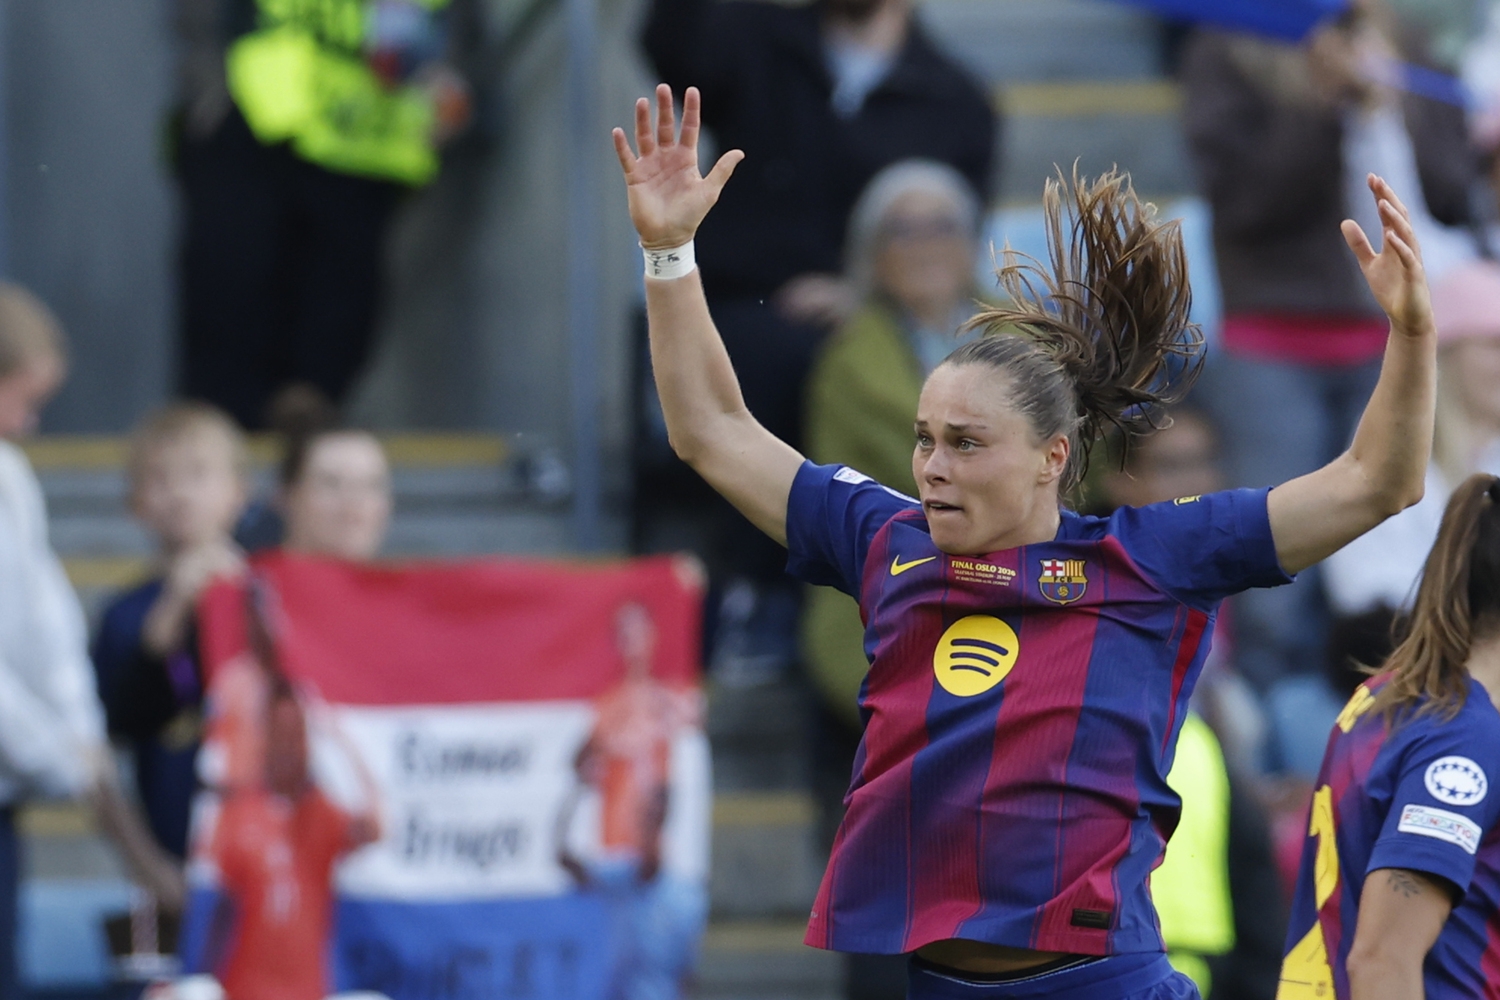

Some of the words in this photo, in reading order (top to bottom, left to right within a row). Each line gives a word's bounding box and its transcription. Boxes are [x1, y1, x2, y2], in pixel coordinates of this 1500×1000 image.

[951, 560, 974, 572] FINAL
[975, 563, 998, 574] OSLO
[998, 567, 1017, 577] 2026
